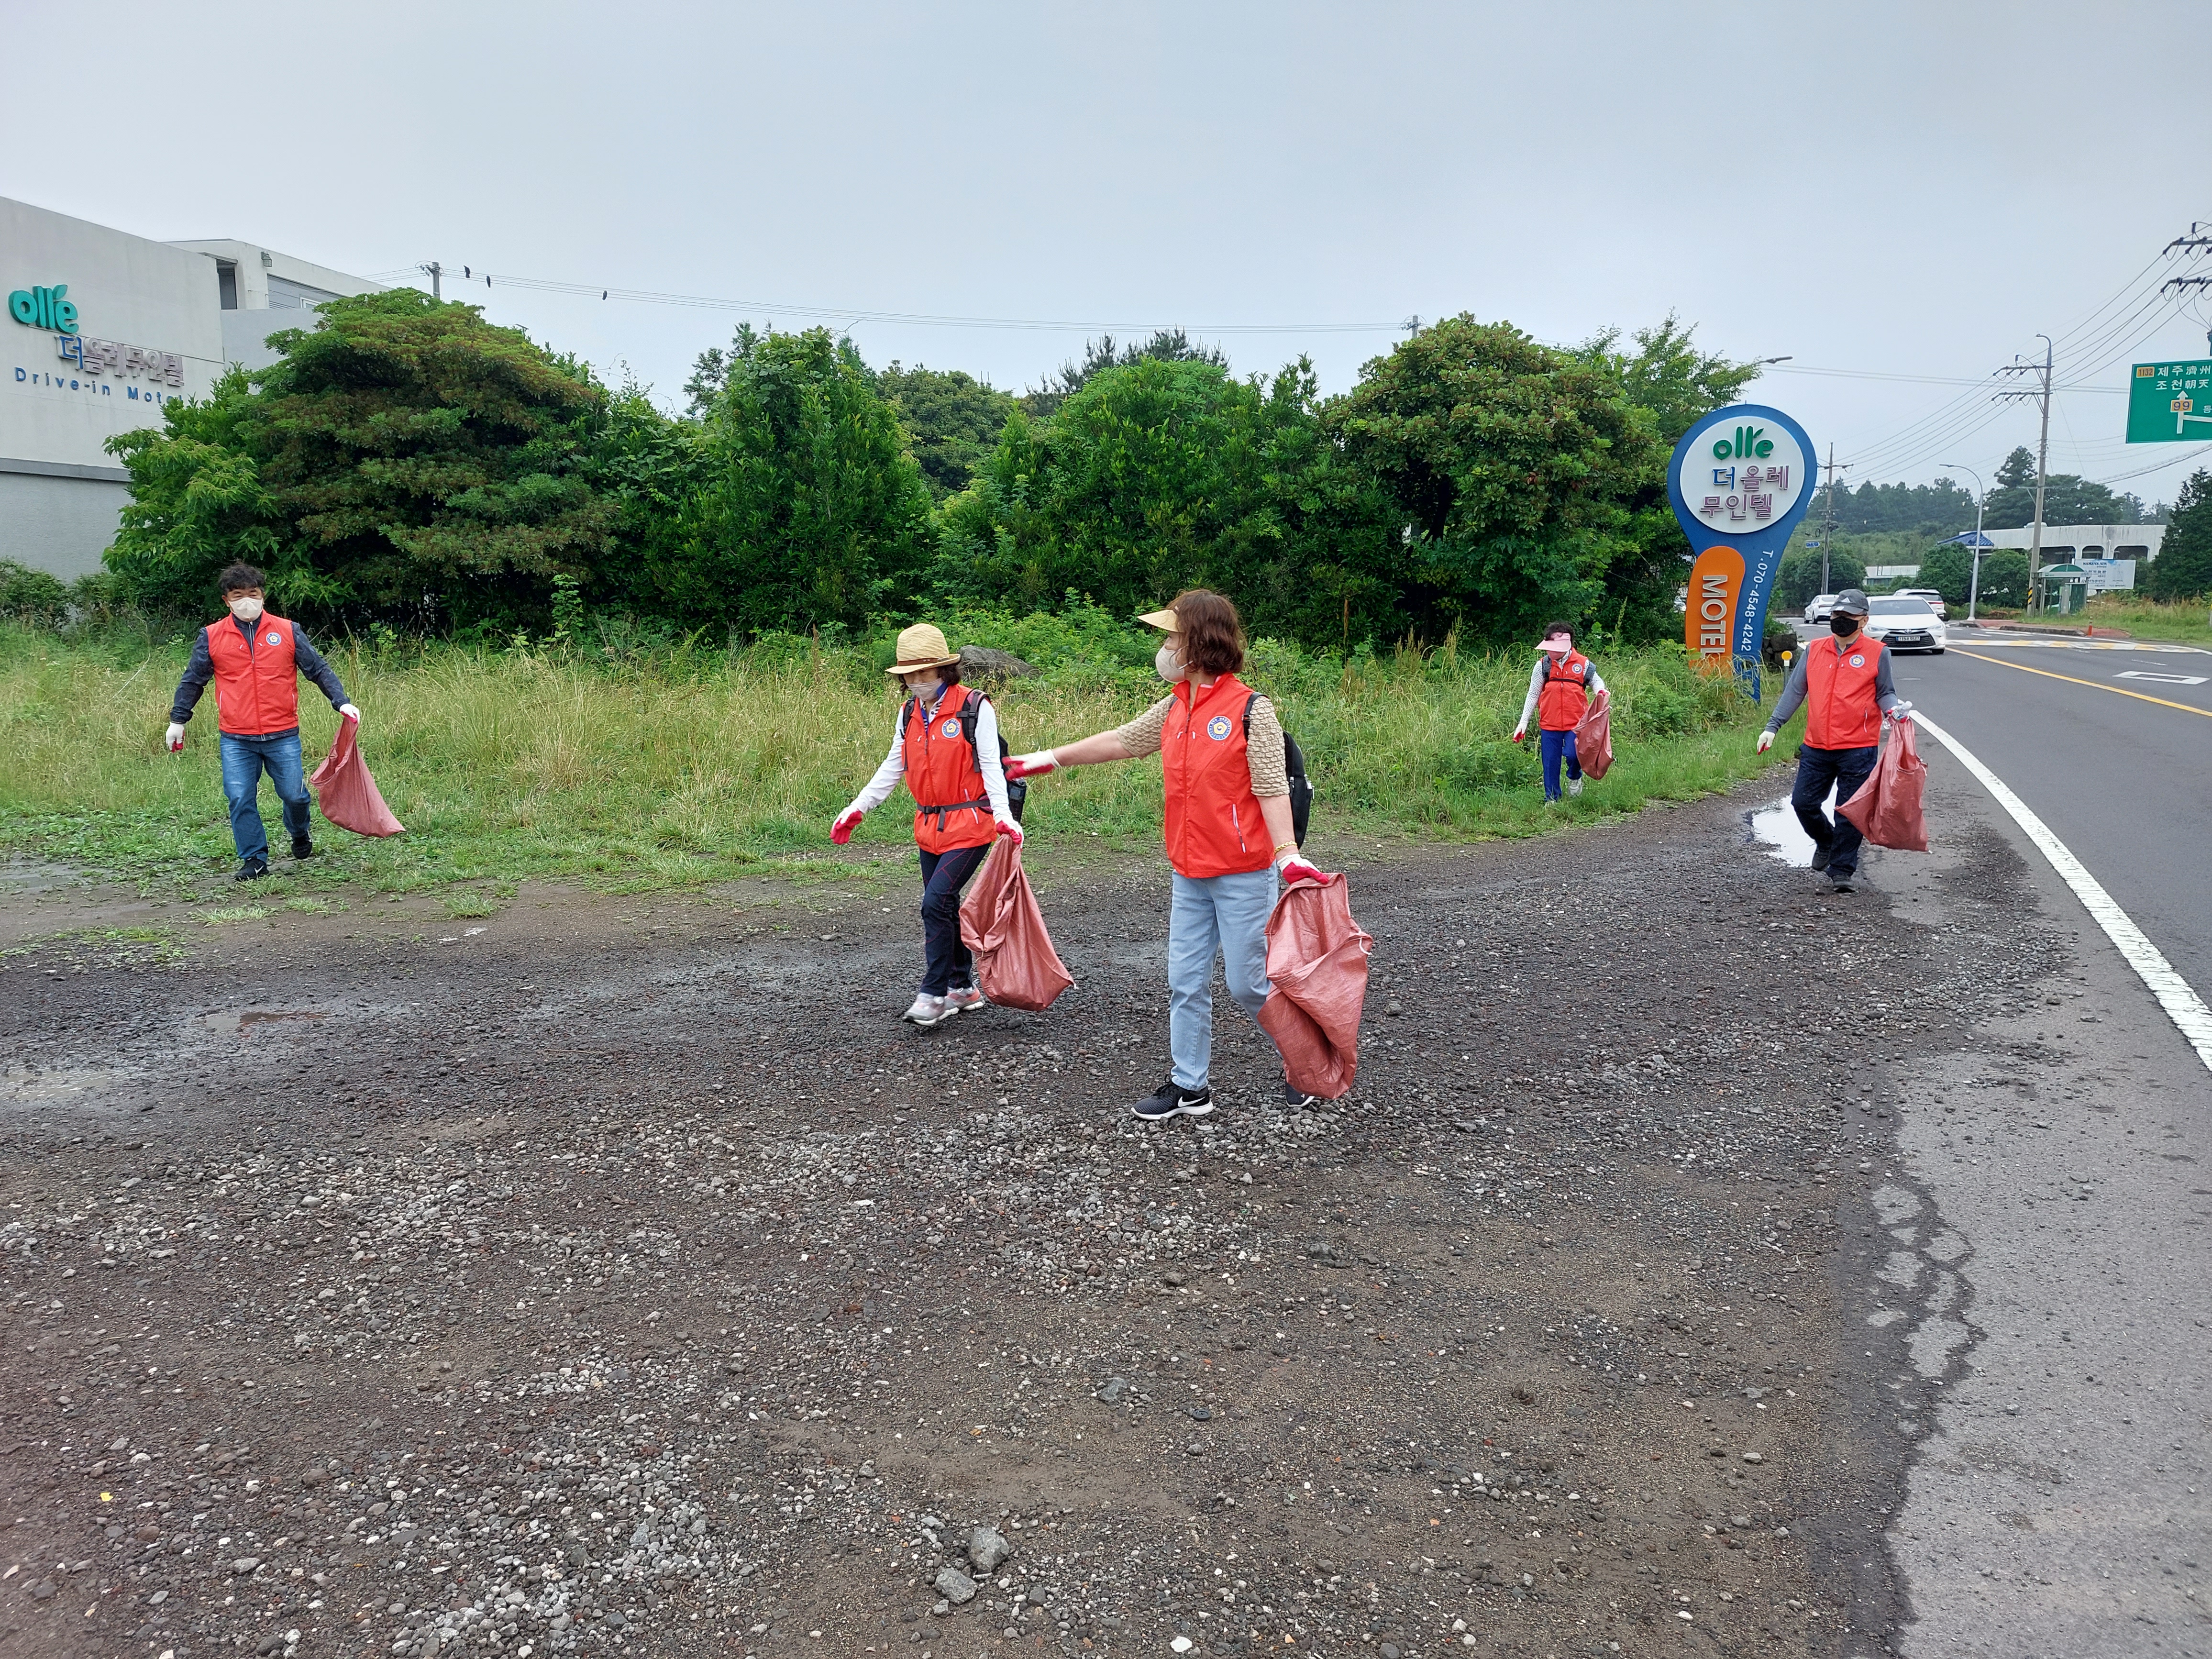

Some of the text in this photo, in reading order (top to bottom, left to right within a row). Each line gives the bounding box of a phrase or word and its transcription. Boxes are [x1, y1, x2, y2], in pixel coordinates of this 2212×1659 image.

[15, 367, 111, 396] Drive-in
[2139, 368, 2153, 376] 1132
[2173, 401, 2190, 411] 99
[1700, 493, 1773, 520] 무인텔
[1700, 575, 1728, 659] MOTEL
